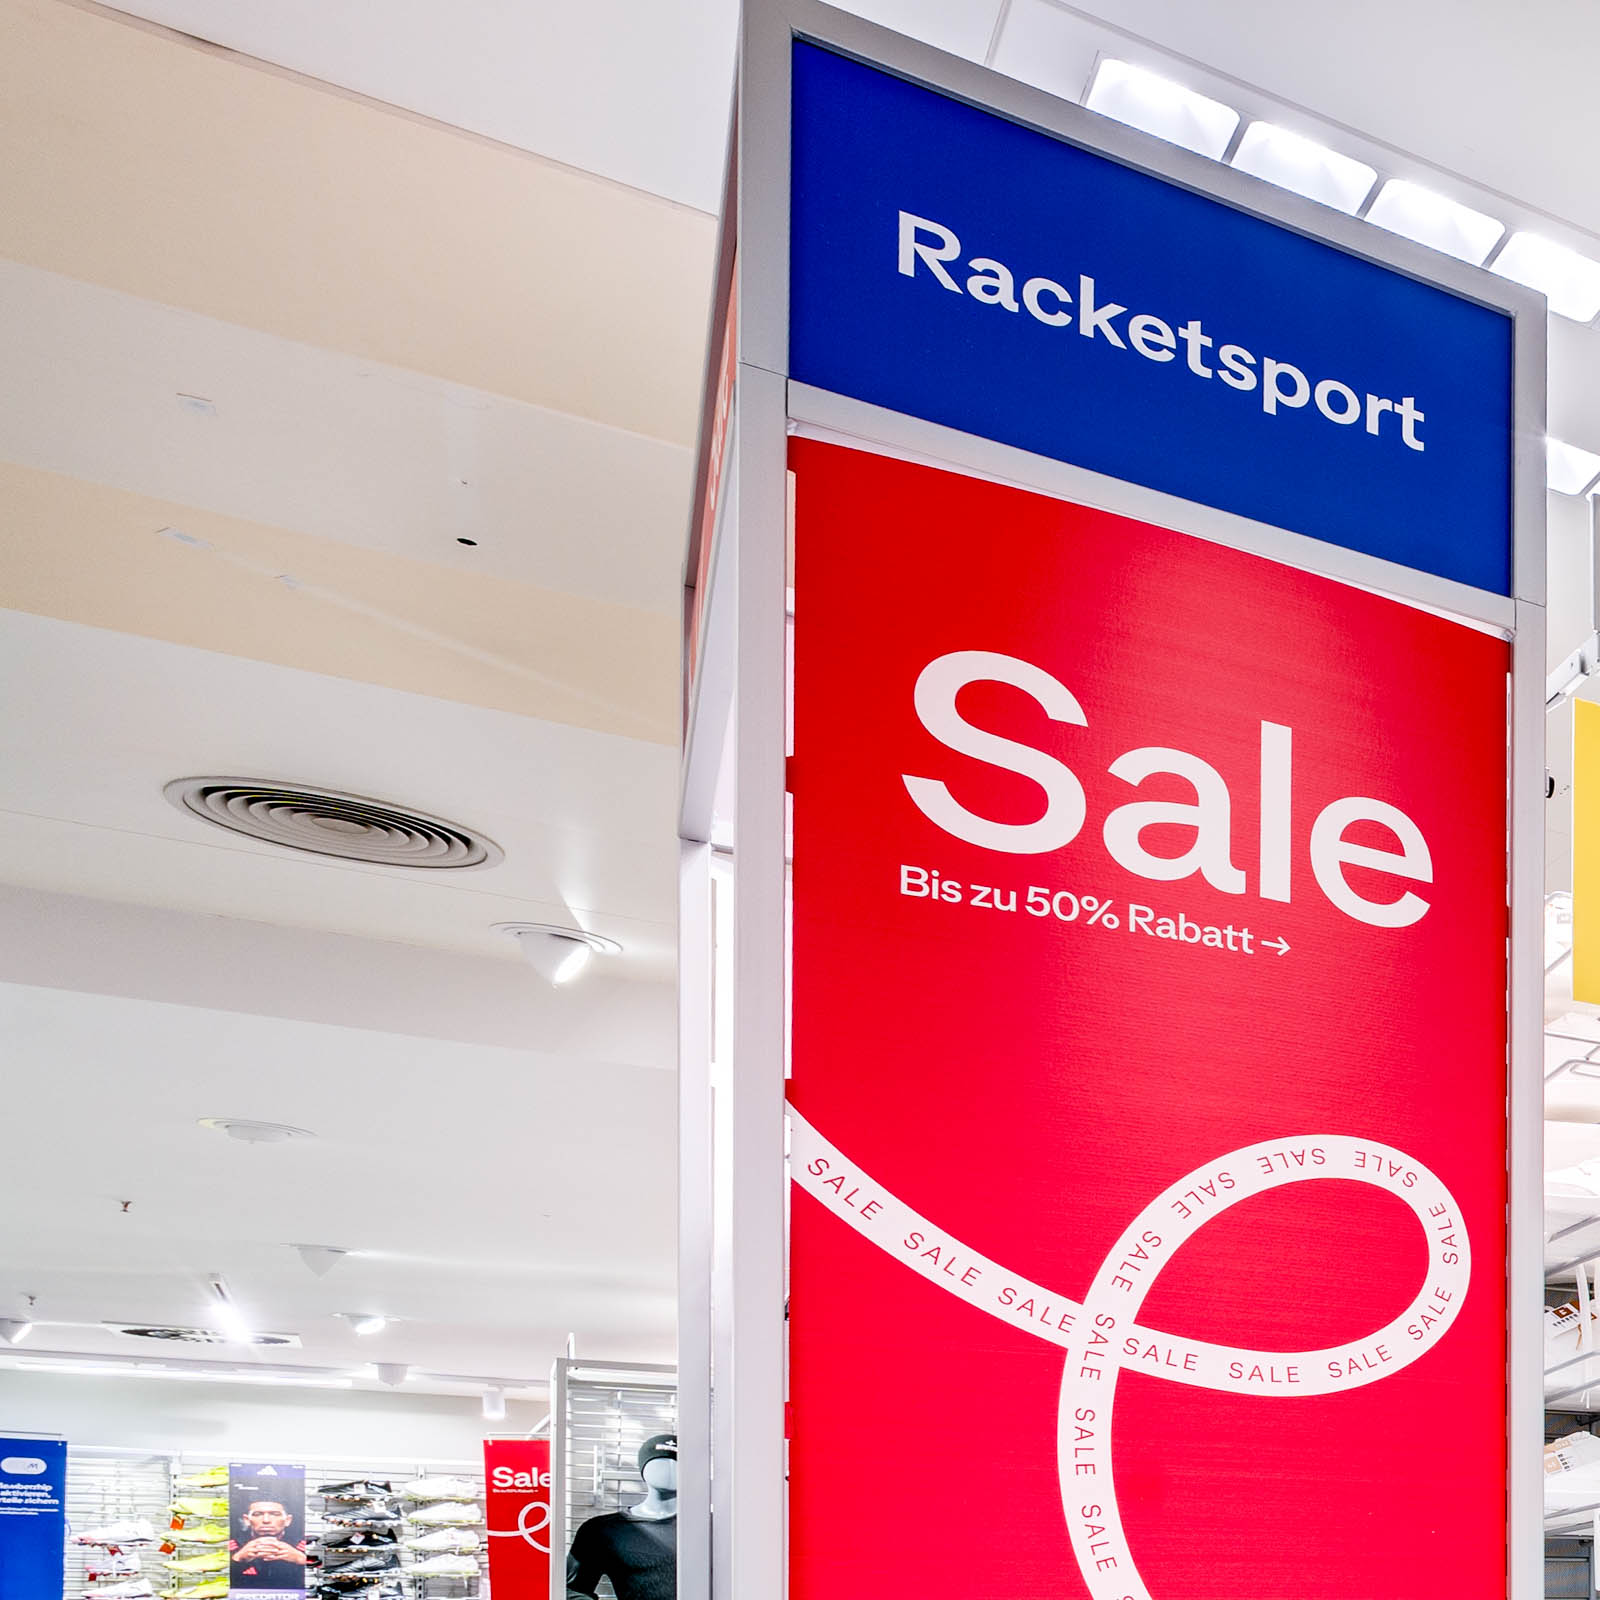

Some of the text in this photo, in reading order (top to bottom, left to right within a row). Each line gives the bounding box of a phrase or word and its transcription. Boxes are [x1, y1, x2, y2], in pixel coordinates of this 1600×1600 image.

[898, 211, 1426, 452] Racketsport
[901, 650, 1434, 928] Sale
[900, 867, 1254, 956] Bis zu 50% Rabatt
[806, 1157, 885, 1222] SALE
[1255, 1147, 1326, 1175] SALE
[1353, 1150, 1419, 1189] SALE
[1171, 1171, 1238, 1221] SALE
[902, 1230, 979, 1288] SALE
[1109, 1229, 1163, 1295] SALE
[1427, 1200, 1460, 1267] SALE
[998, 1285, 1076, 1334] SALE
[1405, 1284, 1454, 1343] SALE
[1078, 1311, 1117, 1381] SALE
[1121, 1335, 1200, 1372] SALE
[1228, 1361, 1301, 1384] SALE
[1327, 1343, 1394, 1380] SALE
[1072, 1406, 1096, 1476] SALE
[1079, 1503, 1119, 1573] SALE
